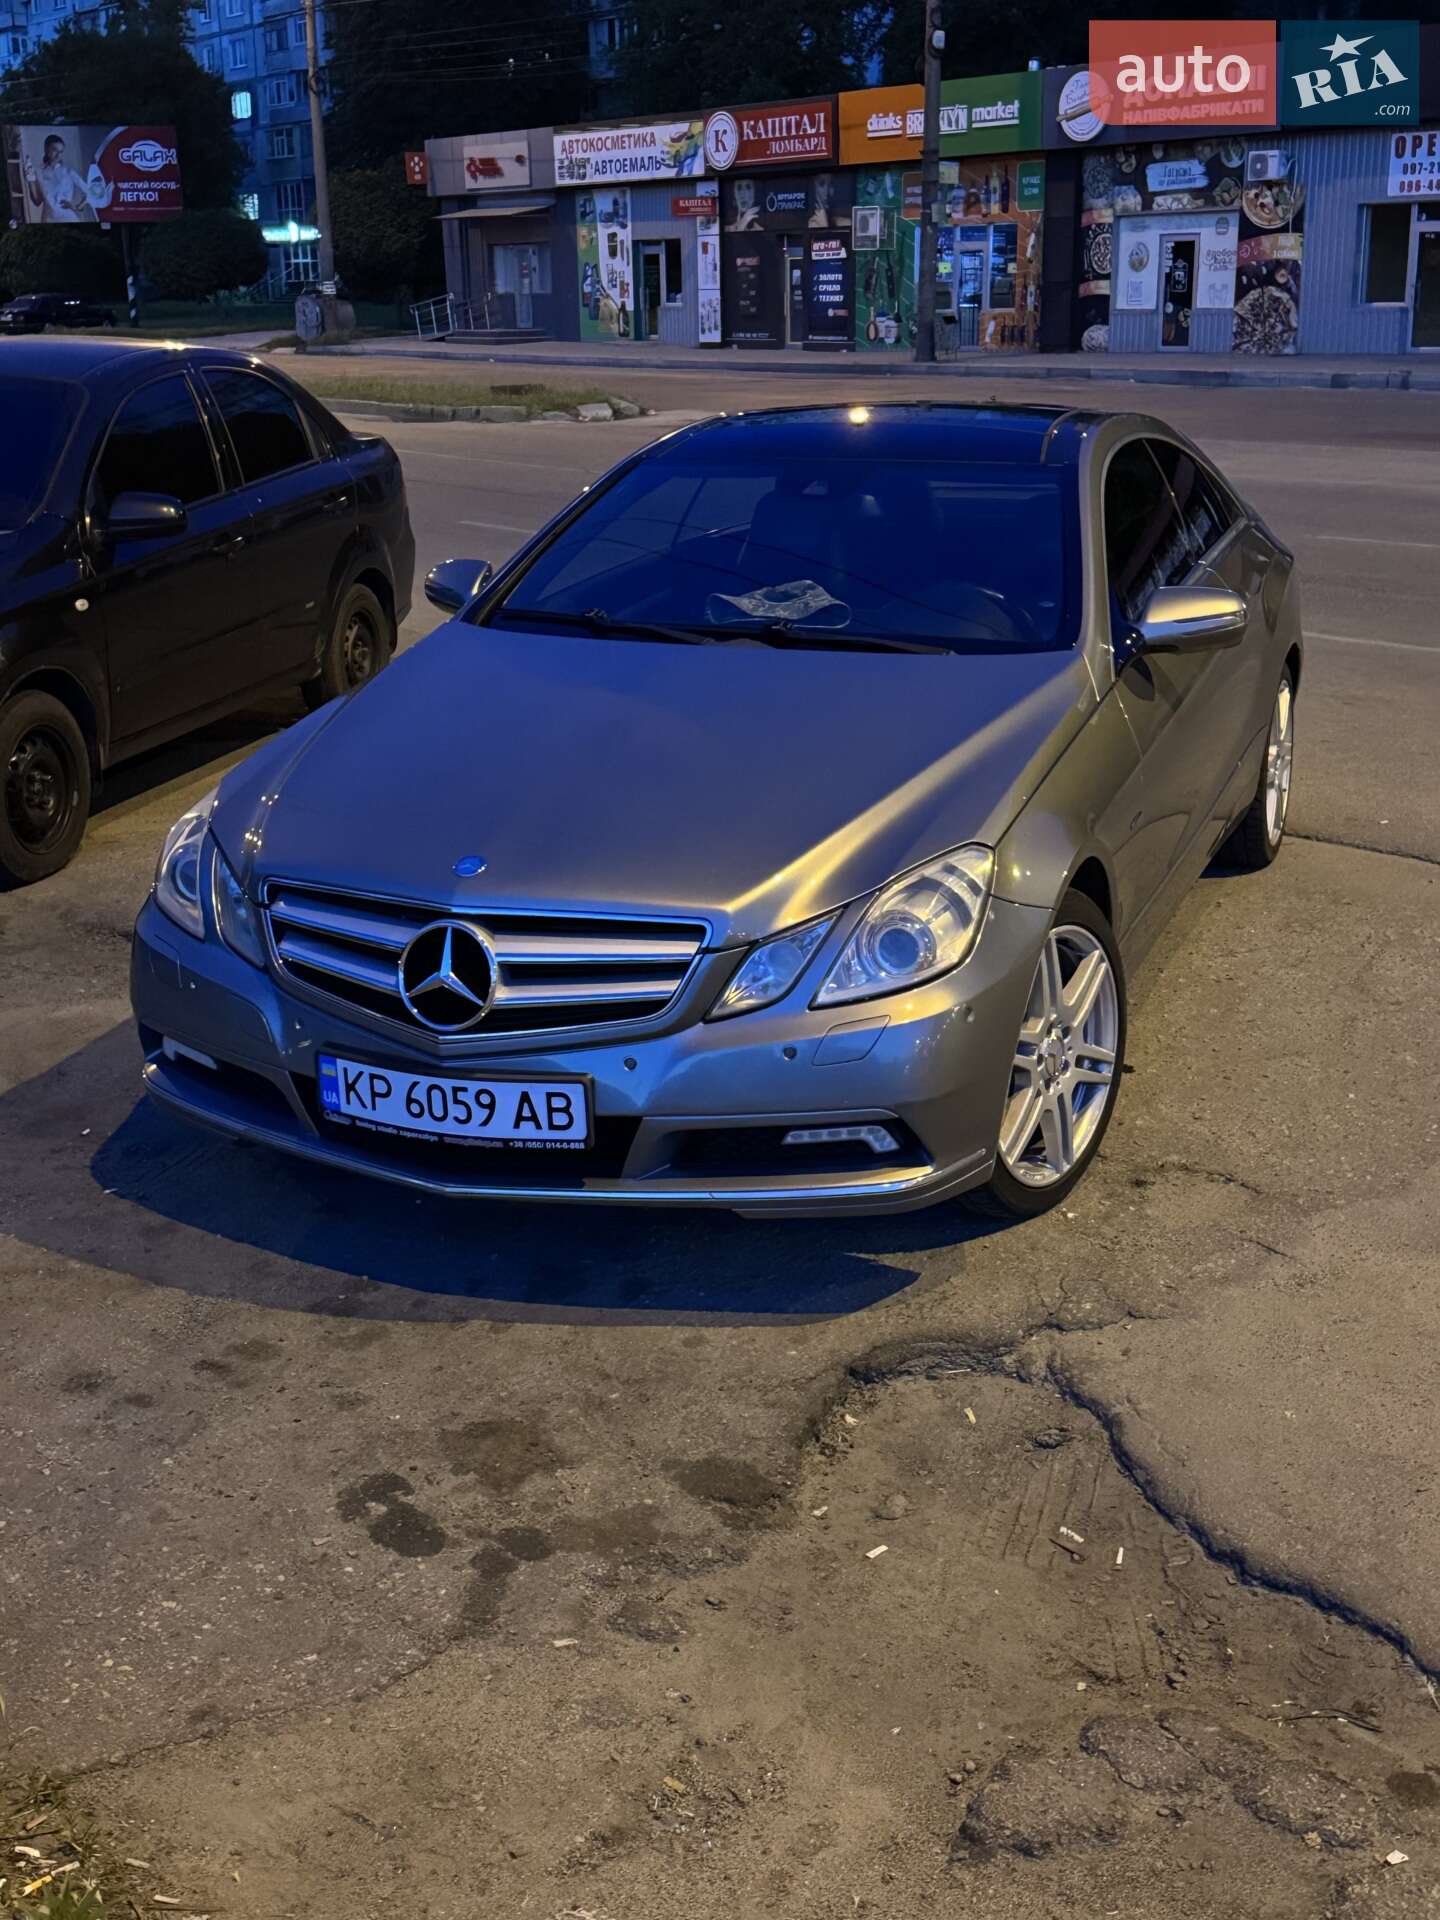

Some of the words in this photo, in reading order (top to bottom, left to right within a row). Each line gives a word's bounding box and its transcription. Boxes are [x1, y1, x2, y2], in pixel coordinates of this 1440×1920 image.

[867, 112, 902, 131] drinks
[971, 100, 1020, 122] market
[742, 112, 826, 141] КАПІТАЛ
[561, 131, 657, 155] АВТОКОСМЕТИКА
[766, 136, 827, 155] ЛОМБАРД
[119, 147, 178, 165] GALAX
[594, 155, 662, 176] АВТОЕМАЛЬ
[119, 191, 160, 202] ЛЕГКО!
[323, 1090, 339, 1105] UA
[342, 1066, 392, 1112] KP
[405, 1080, 497, 1127] 6059
[512, 1090, 575, 1132] AB
